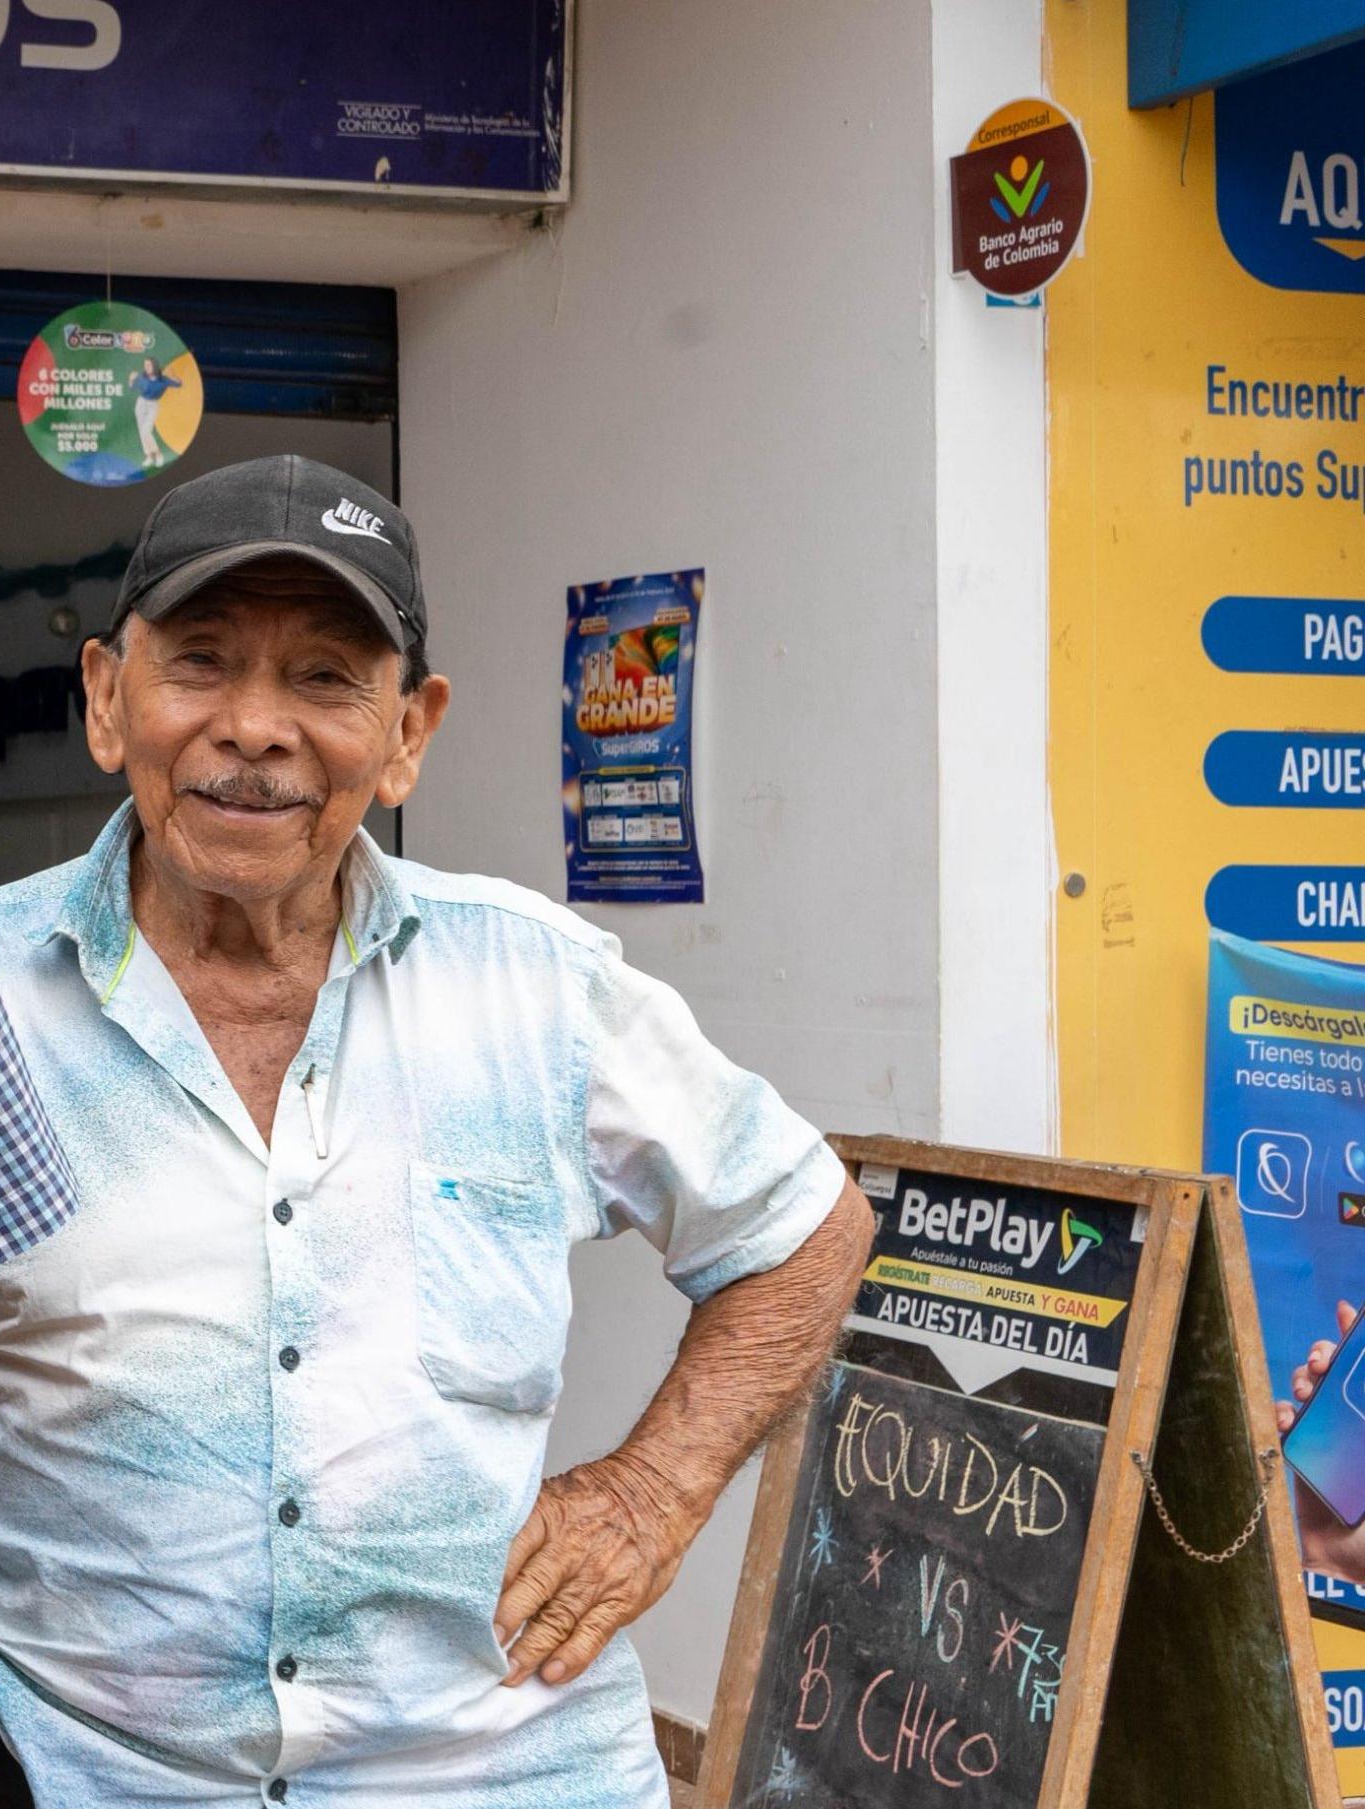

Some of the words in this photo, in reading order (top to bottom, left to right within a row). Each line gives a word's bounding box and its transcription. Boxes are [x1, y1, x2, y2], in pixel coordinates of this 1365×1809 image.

[337, 118, 420, 134] CONTROLADO
[344, 105, 401, 119] VIGILADO
[402, 108, 412, 119] Y
[978, 111, 1050, 145] Corresponsal
[1279, 150, 1364, 231] AQ
[979, 231, 1016, 253] Banco
[1019, 218, 1064, 244] Agrario
[984, 253, 1000, 270] de
[1003, 239, 1060, 266] Colombia
[29, 383, 60, 396] CON
[63, 384, 103, 397] MILES
[105, 384, 123, 397] DE
[38, 370, 48, 382] 6
[51, 370, 114, 383] COLORES
[43, 397, 112, 411] MILLONES
[1184, 450, 1304, 507] puntos
[1316, 449, 1365, 515] Su
[334, 497, 385, 533] NIKE
[1304, 613, 1363, 662] PAG
[584, 678, 635, 704] GANA
[642, 673, 675, 698] EN
[576, 694, 677, 733] GRANDE
[1278, 746, 1365, 794] APUE
[1297, 881, 1365, 928] CHA
[1243, 1003, 1365, 1039] ¡Descárgal
[1246, 1039, 1314, 1067] Tienes
[1319, 1048, 1363, 1072] todo
[1236, 1067, 1337, 1095] necesitas
[1341, 1080, 1353, 1097] a
[1357, 1076, 1365, 1099] l
[898, 1188, 1055, 1269] BetPlay
[911, 1247, 958, 1267] Apuéstale
[959, 1258, 967, 1268] a
[968, 1258, 979, 1271] tu
[980, 1261, 1013, 1276] pasión
[878, 1262, 930, 1285] REGÍSTRATE
[932, 1273, 984, 1296] RECARGA
[985, 1286, 1035, 1306] APUESTA
[1041, 1294, 1049, 1311] Y
[1054, 1297, 1099, 1320] GANA
[877, 1292, 984, 1343] APUESTA
[990, 1311, 1038, 1353] DEL
[1045, 1321, 1089, 1364] DÍA
[920, 1555, 969, 1663] VS
[796, 1623, 832, 1730] B
[857, 1669, 998, 1788] CHICO
[1324, 1686, 1365, 1733] SO
